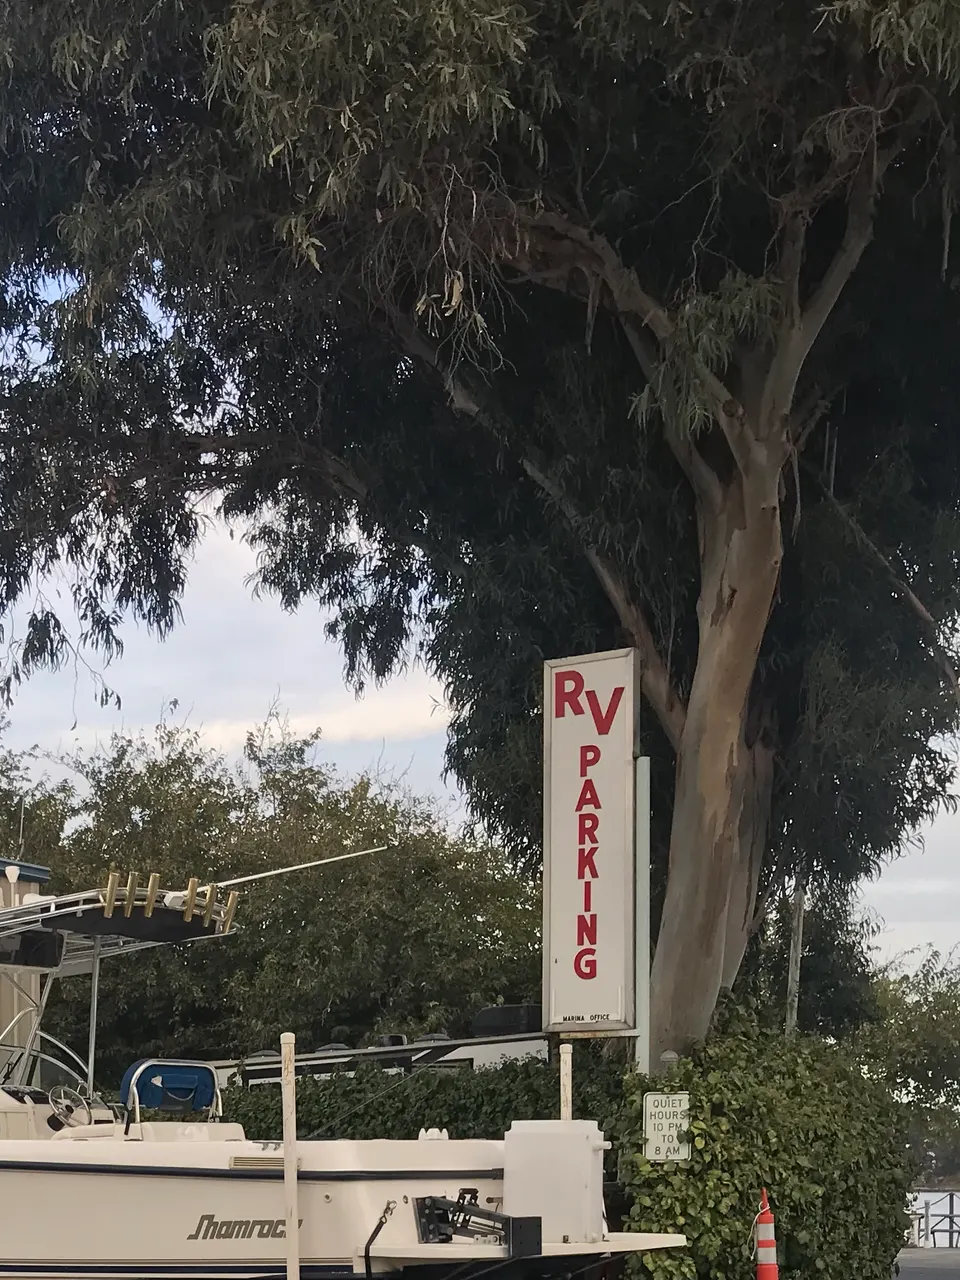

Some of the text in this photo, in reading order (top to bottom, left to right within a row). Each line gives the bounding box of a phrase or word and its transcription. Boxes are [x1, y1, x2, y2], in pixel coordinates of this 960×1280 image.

[555, 670, 625, 735] RV
[574, 745, 602, 980] PARKING
[653, 1099, 683, 1108] QUIET
[650, 1111, 686, 1120] HOURS
[653, 1123, 682, 1131] 10 PM
[662, 1135, 674, 1143] TO
[655, 1146, 680, 1155] 8 AM
[186, 1214, 303, 1240] Shamroc
